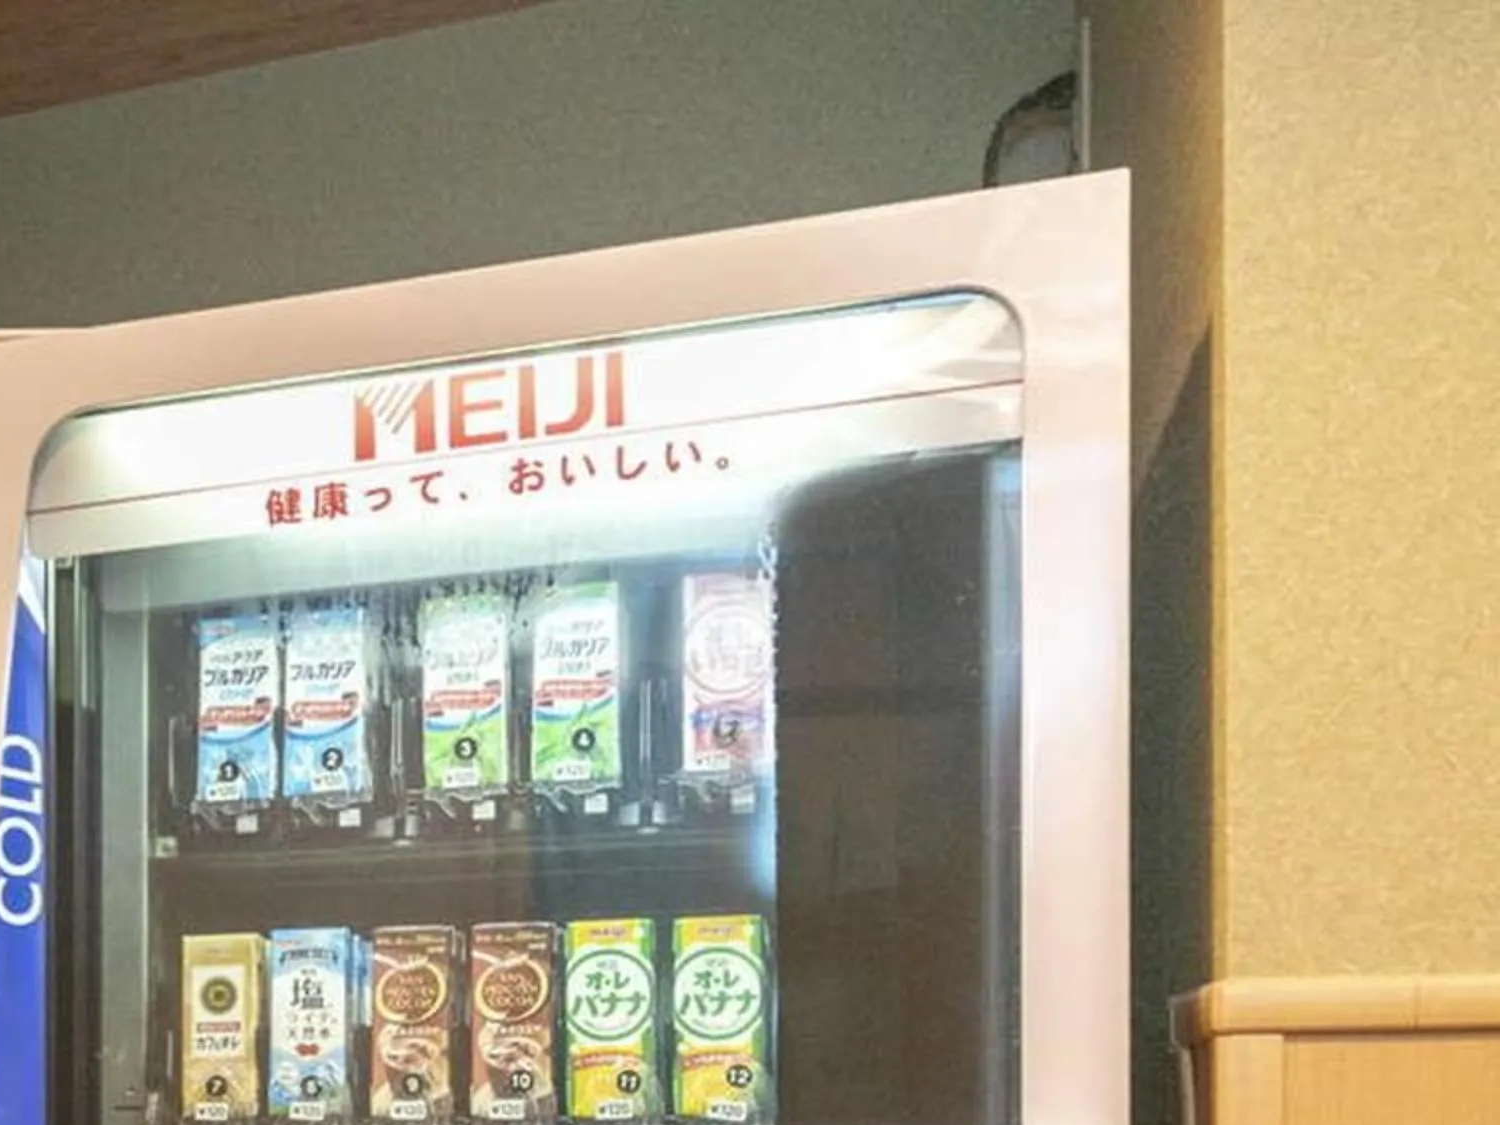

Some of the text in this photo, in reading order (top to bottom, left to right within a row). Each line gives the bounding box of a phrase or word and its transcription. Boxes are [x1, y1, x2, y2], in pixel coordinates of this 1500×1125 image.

[355, 351, 625, 462] MEIJI
[572, 989, 647, 1018] バナナ
[680, 988, 757, 1016] バナナ
